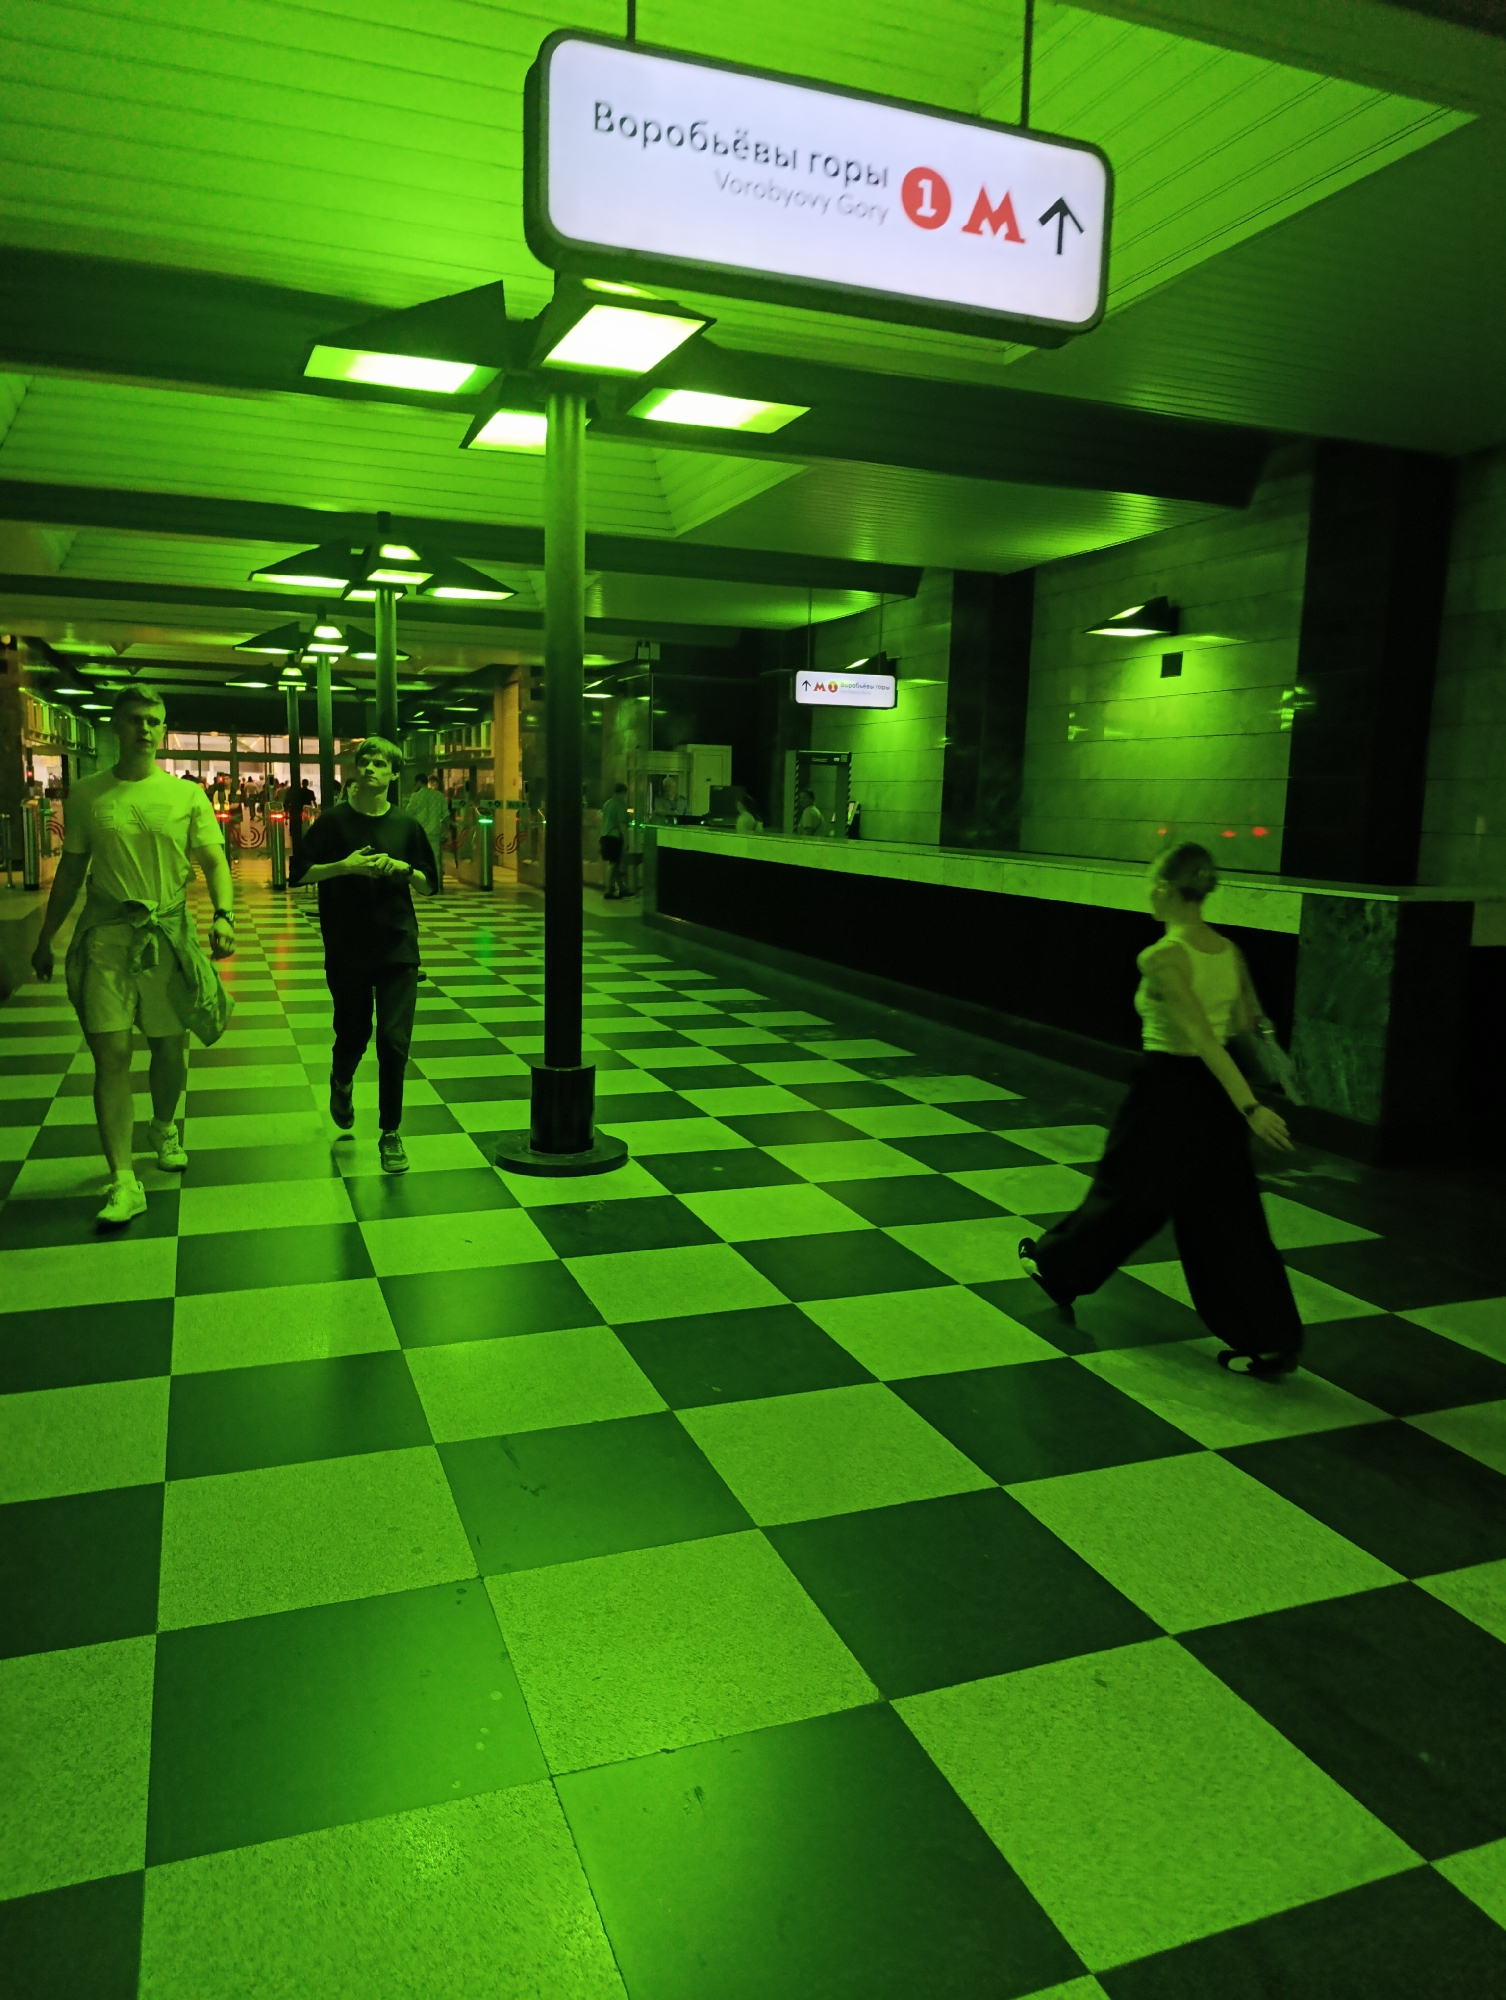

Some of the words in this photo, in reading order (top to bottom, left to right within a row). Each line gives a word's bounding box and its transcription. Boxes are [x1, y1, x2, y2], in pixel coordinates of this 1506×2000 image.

[594, 101, 797, 170] Воробьёвы
[808, 152, 889, 188] горы
[916, 178, 938, 218] 1
[713, 168, 832, 215] Vorobyovy
[836, 193, 889, 226] Gory
